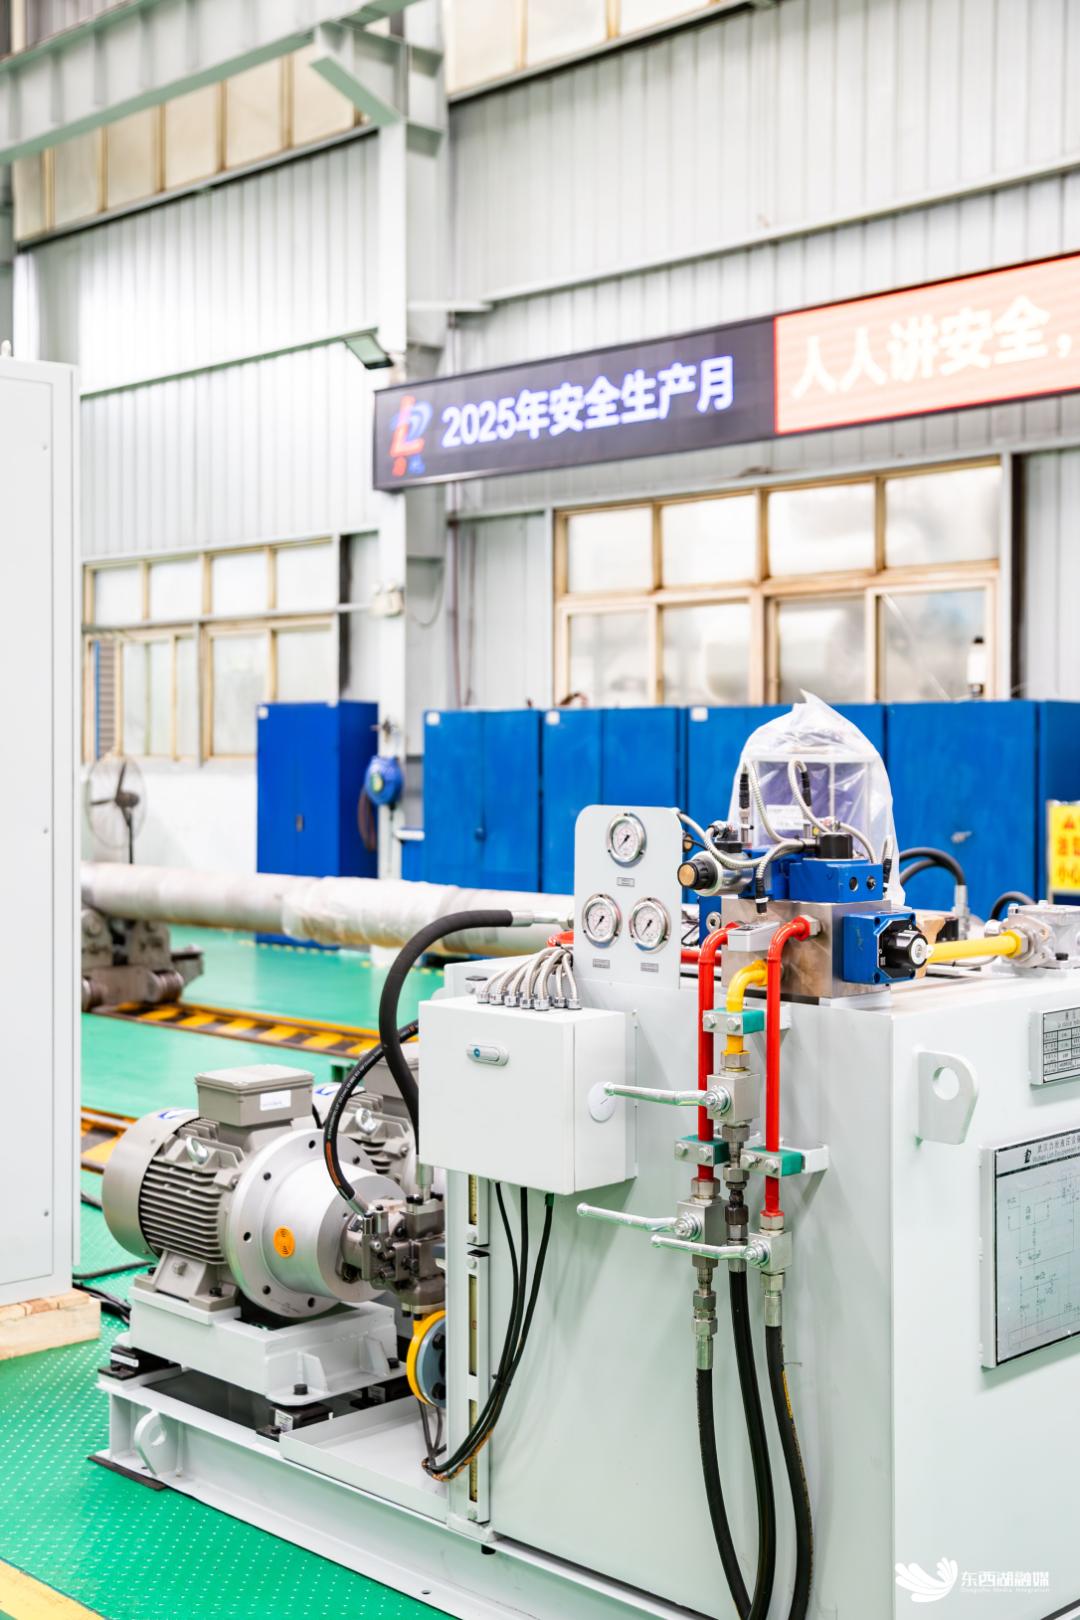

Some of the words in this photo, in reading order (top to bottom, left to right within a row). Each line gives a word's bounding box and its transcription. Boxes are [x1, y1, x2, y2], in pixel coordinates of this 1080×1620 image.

[441, 355, 734, 448] 2025年安全生产月
